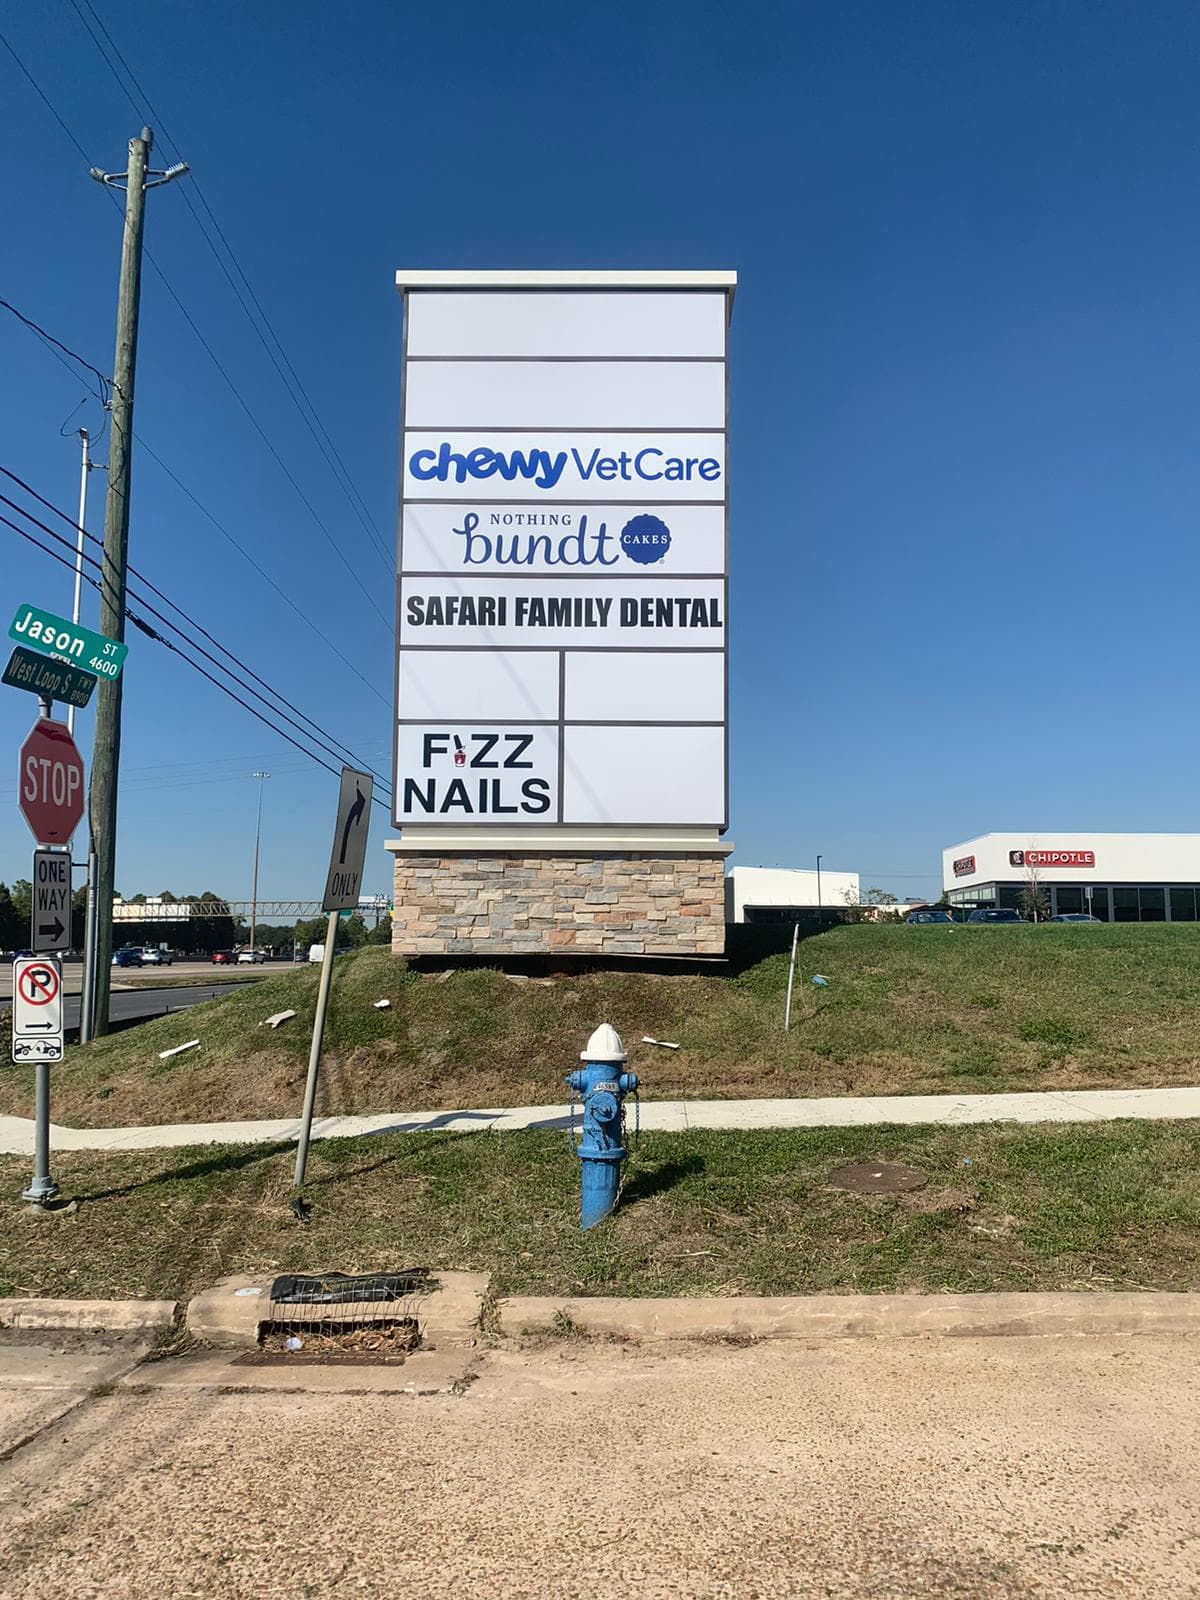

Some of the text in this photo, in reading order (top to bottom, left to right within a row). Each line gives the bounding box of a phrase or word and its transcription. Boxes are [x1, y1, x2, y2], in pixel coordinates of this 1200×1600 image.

[409, 442, 568, 489] chewy
[490, 513, 572, 526] NOTHING
[452, 512, 668, 565] bundt CAKES
[407, 596, 722, 627] SAFARI FAMILY DENTAL
[15, 612, 118, 657] Jason ST
[8, 654, 72, 694] West Loop S
[89, 656, 117, 676] 4600
[24, 755, 80, 807] STOP
[403, 778, 551, 813] NAILS
[38, 860, 65, 883] ONE
[1028, 853, 1092, 863] CHIPOTLE
[38, 888, 67, 911] WAY
[332, 872, 358, 897] ONLY
